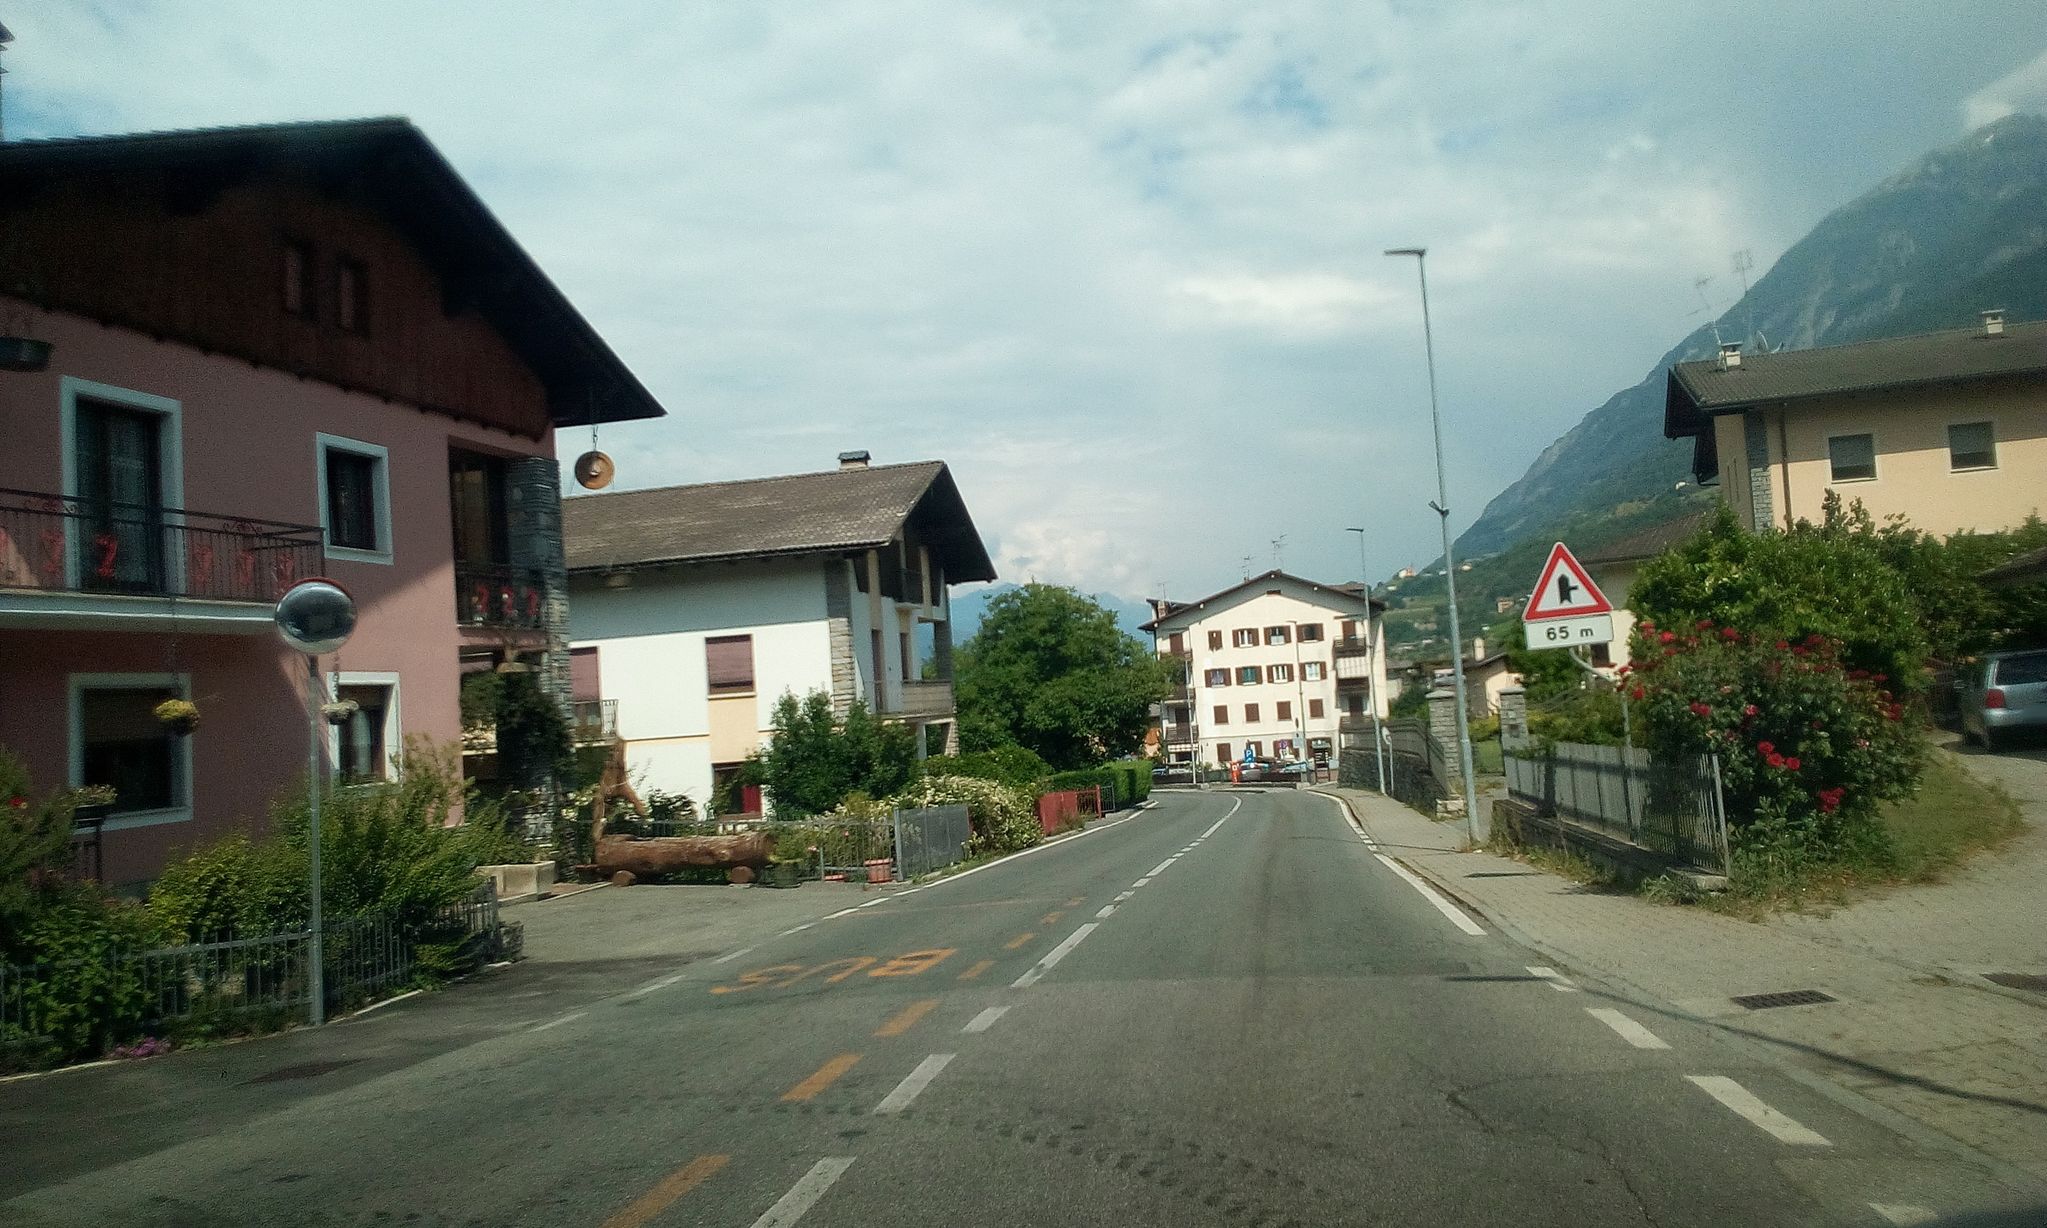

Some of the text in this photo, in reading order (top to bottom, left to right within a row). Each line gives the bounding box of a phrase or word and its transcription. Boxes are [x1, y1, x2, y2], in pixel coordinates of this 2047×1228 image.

[1546, 626, 1594, 640] 65 m
[709, 948, 957, 994] BUS
